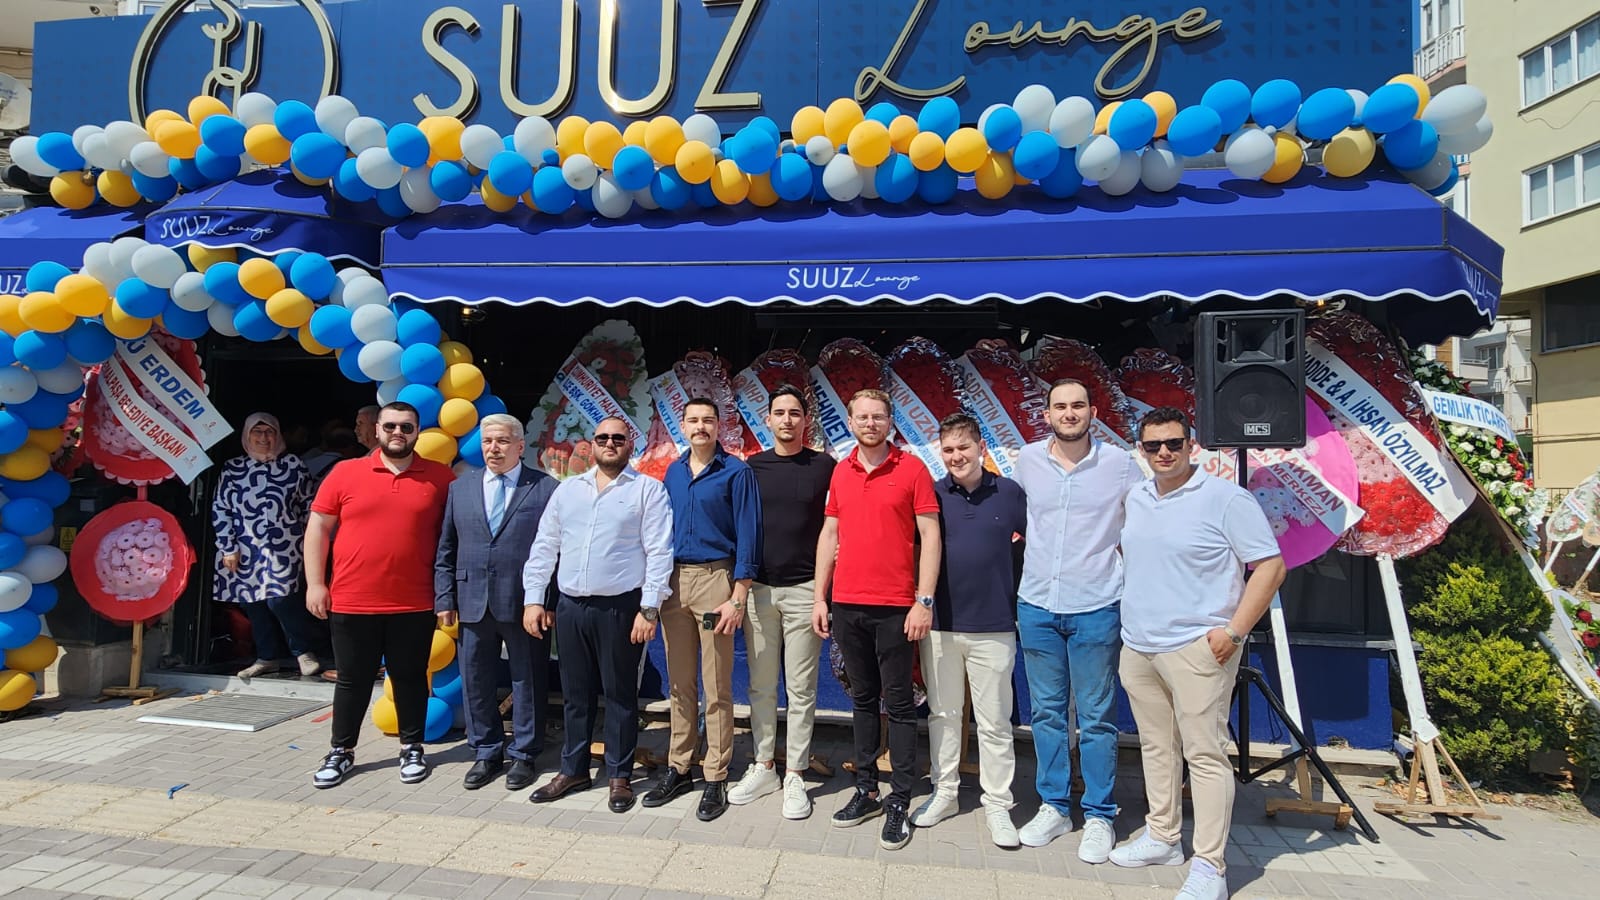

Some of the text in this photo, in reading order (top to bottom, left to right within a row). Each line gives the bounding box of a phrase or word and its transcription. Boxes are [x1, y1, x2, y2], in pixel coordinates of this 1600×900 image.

[413, 0, 1223, 119] SUUZ Lounge
[160, 215, 274, 241] SUUZ Lounge
[786, 267, 920, 291] SUUZ Lounge
[139, 353, 205, 420] ERDEM
[599, 396, 619, 416] HALK
[966, 372, 1001, 423] SADETTİN
[1325, 380, 1347, 397] &
[1335, 389, 1356, 407] A.
[118, 394, 154, 431] BELEDİYE
[146, 424, 188, 458] BAŞKANI
[657, 401, 679, 436] MUTLU
[812, 380, 851, 444] MEHMET
[1348, 396, 1391, 438] İHSAN
[1433, 396, 1474, 420] GEMLİK
[980, 425, 1009, 466] BORSASI
[1245, 424, 1269, 434] MCS
[1383, 430, 1447, 495] ÖZYILMAZ
[1271, 464, 1328, 517] MERKEZİ
